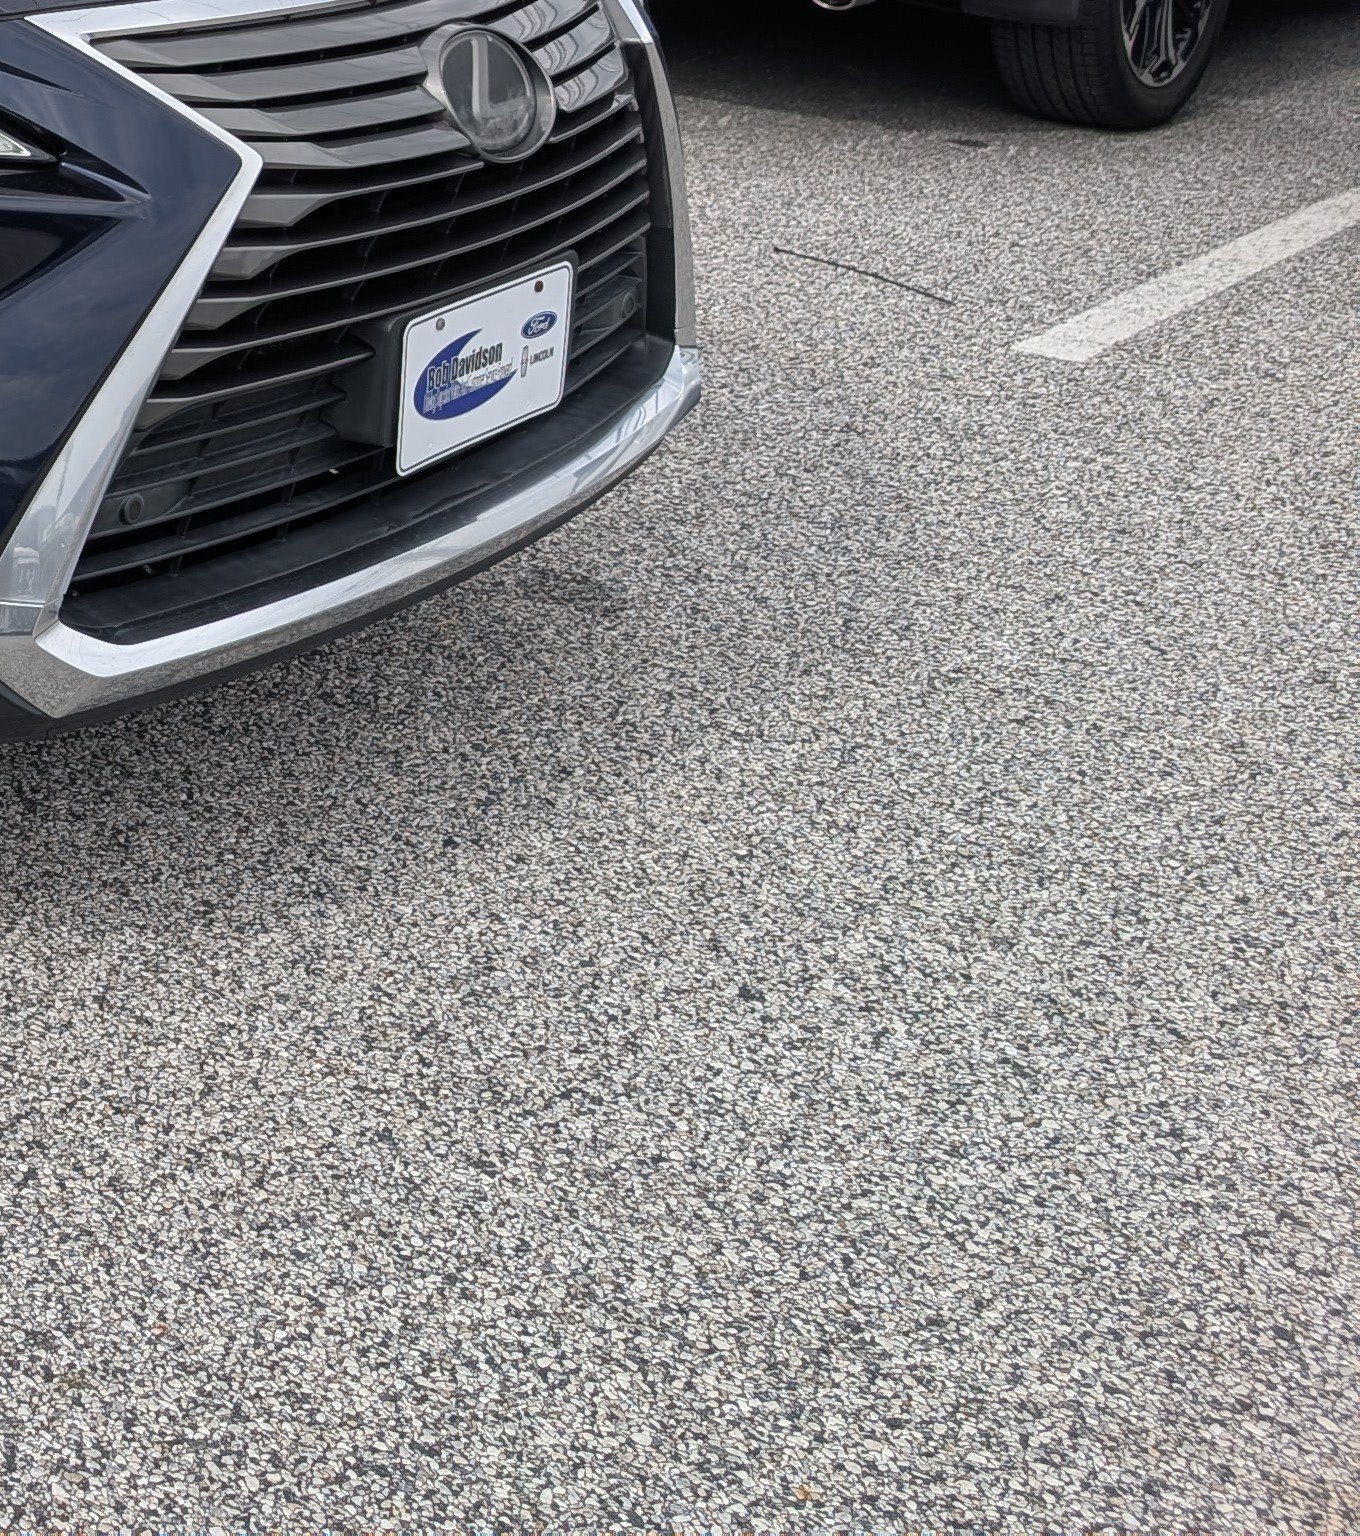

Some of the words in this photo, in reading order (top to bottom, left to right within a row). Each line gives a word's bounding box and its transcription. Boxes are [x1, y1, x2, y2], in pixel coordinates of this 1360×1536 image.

[526, 314, 552, 336] Ford
[427, 358, 451, 391] Bob
[451, 342, 503, 381] Davidson
[529, 347, 555, 365] LINCOLN
